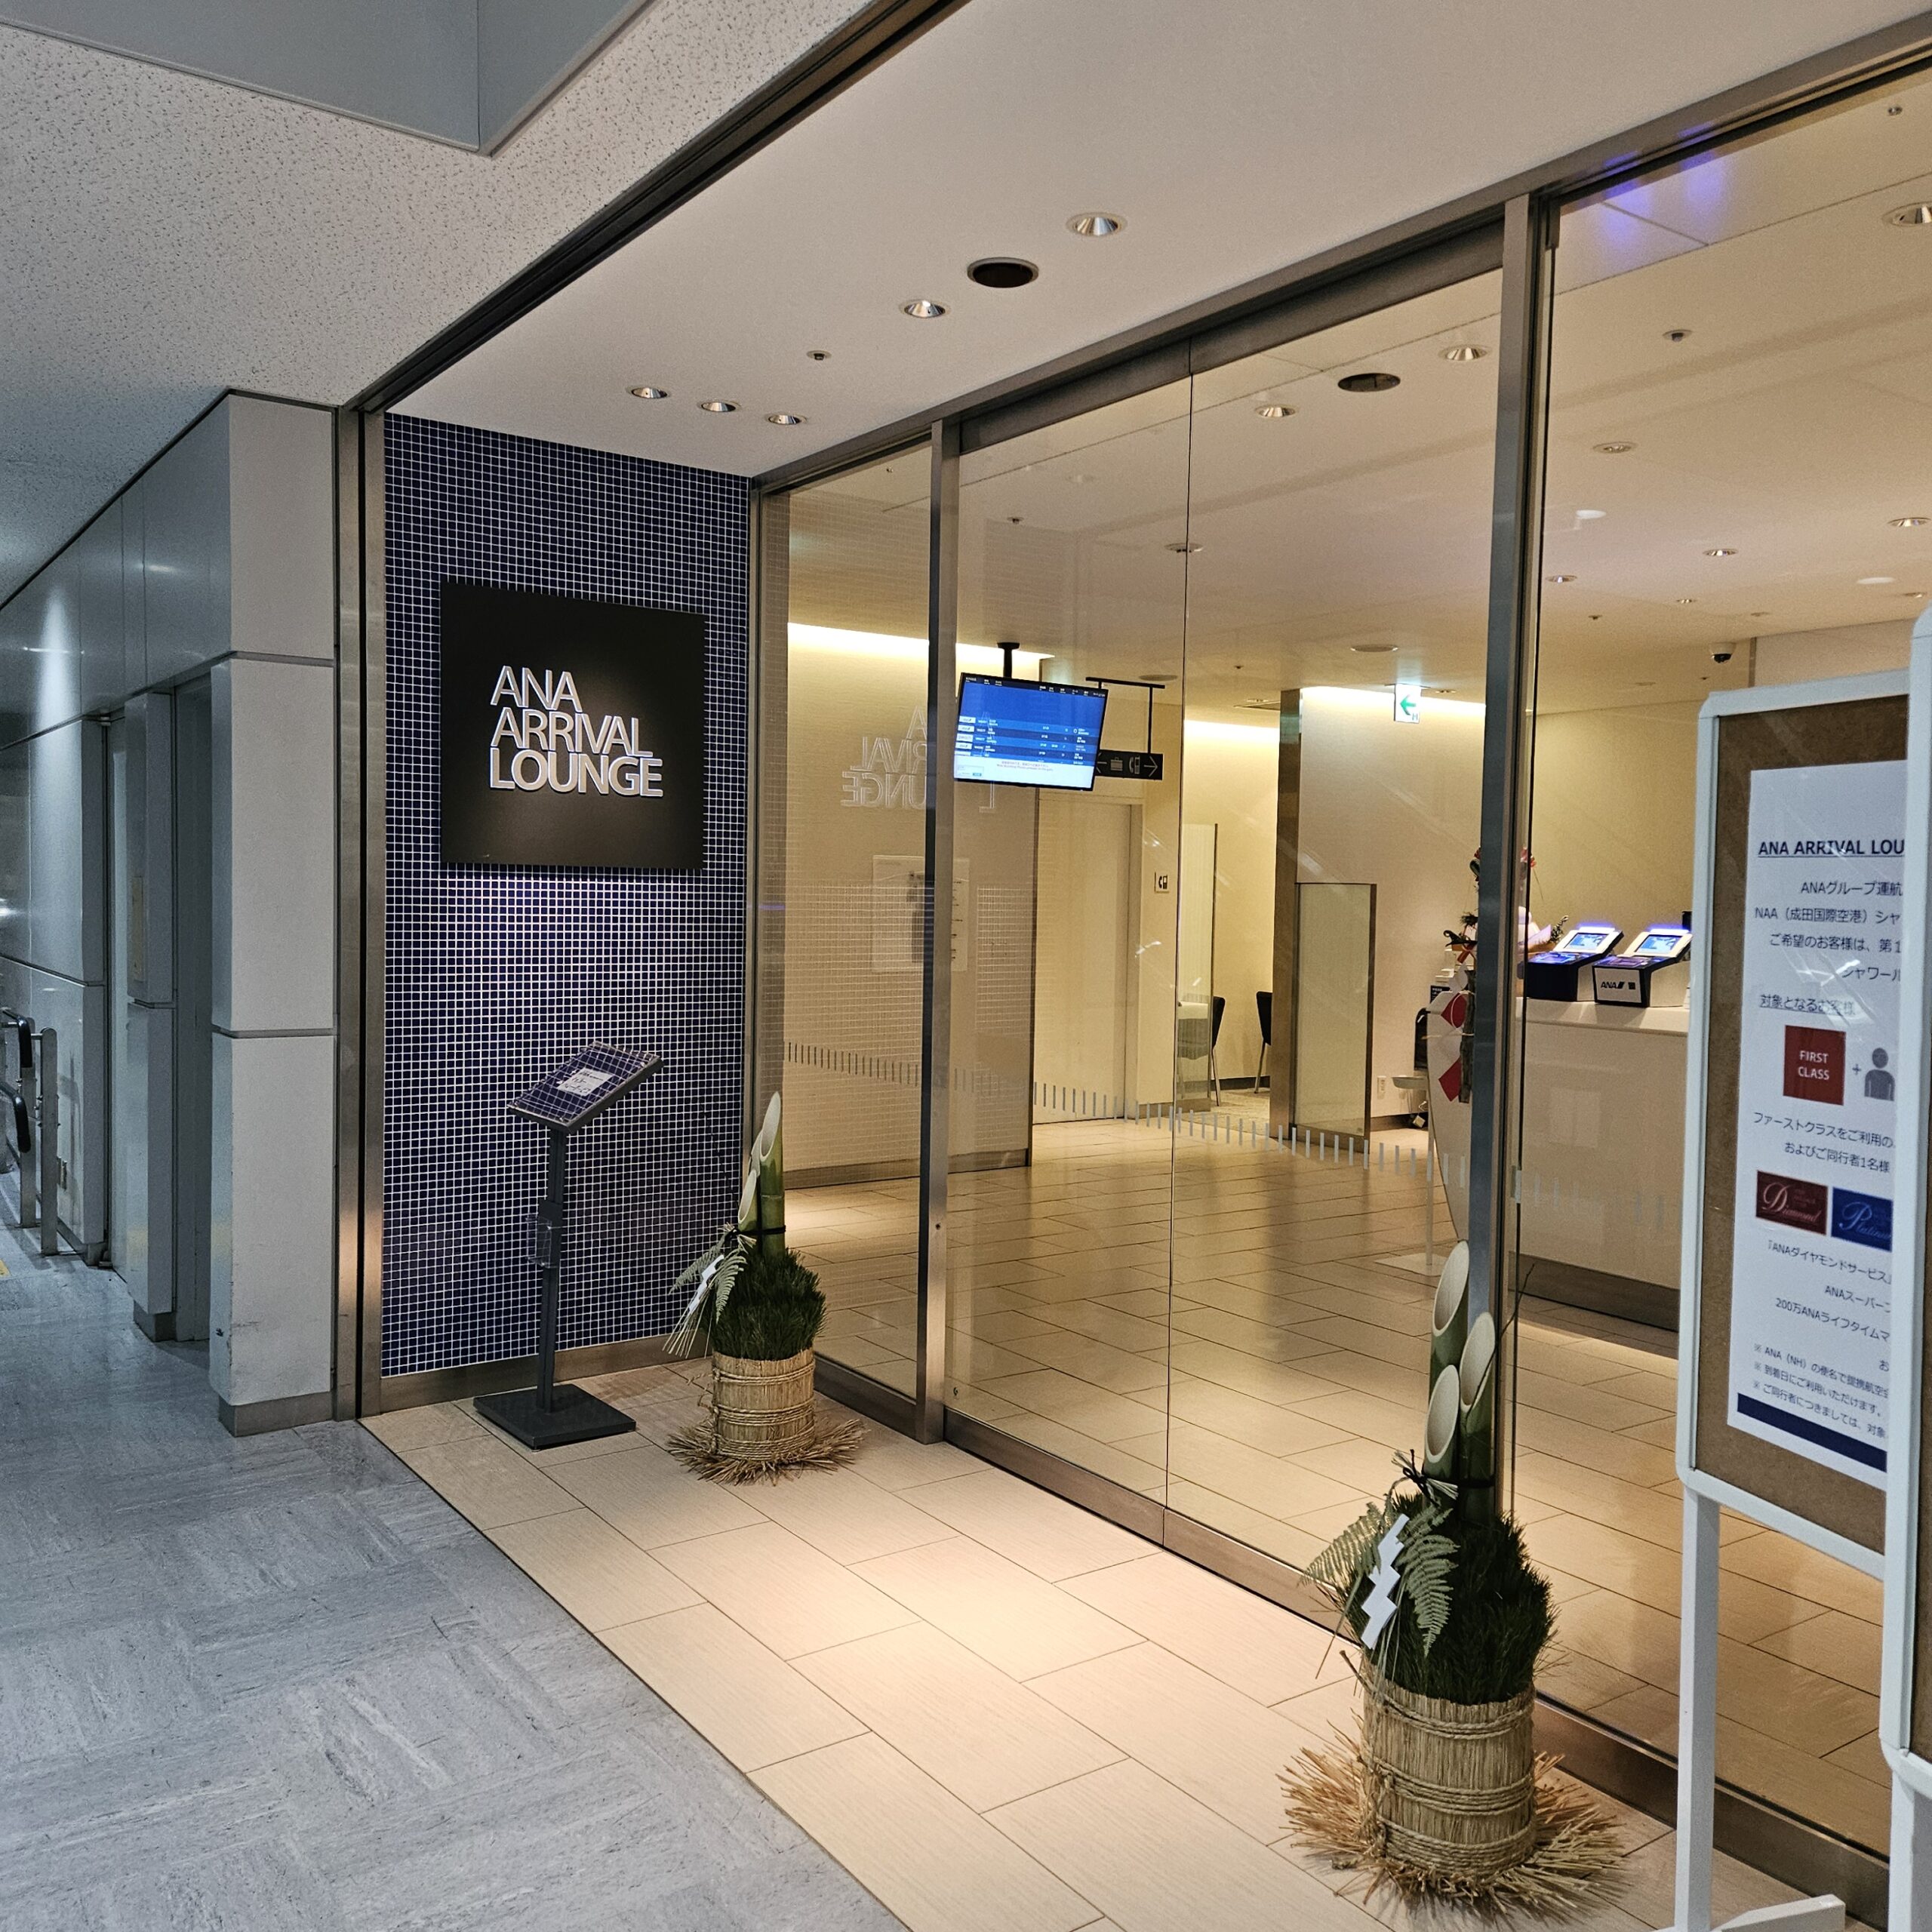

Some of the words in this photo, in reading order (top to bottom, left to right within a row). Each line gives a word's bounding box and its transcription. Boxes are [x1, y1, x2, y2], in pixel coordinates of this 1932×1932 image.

[491, 665, 583, 712] ANA
[491, 706, 653, 757] ARRIVAL
[490, 747, 663, 797] LOUNGE
[1758, 841, 1789, 855] ANA
[1794, 839, 1865, 854] ARRIVAL
[1872, 839, 1905, 854] LOU
[1601, 981, 1617, 989] ANA
[1799, 1051, 1829, 1063] FIRST
[1798, 1066, 1830, 1080] CLASS
[1753, 1112, 1895, 1149] ファーストクラスをご利用の
